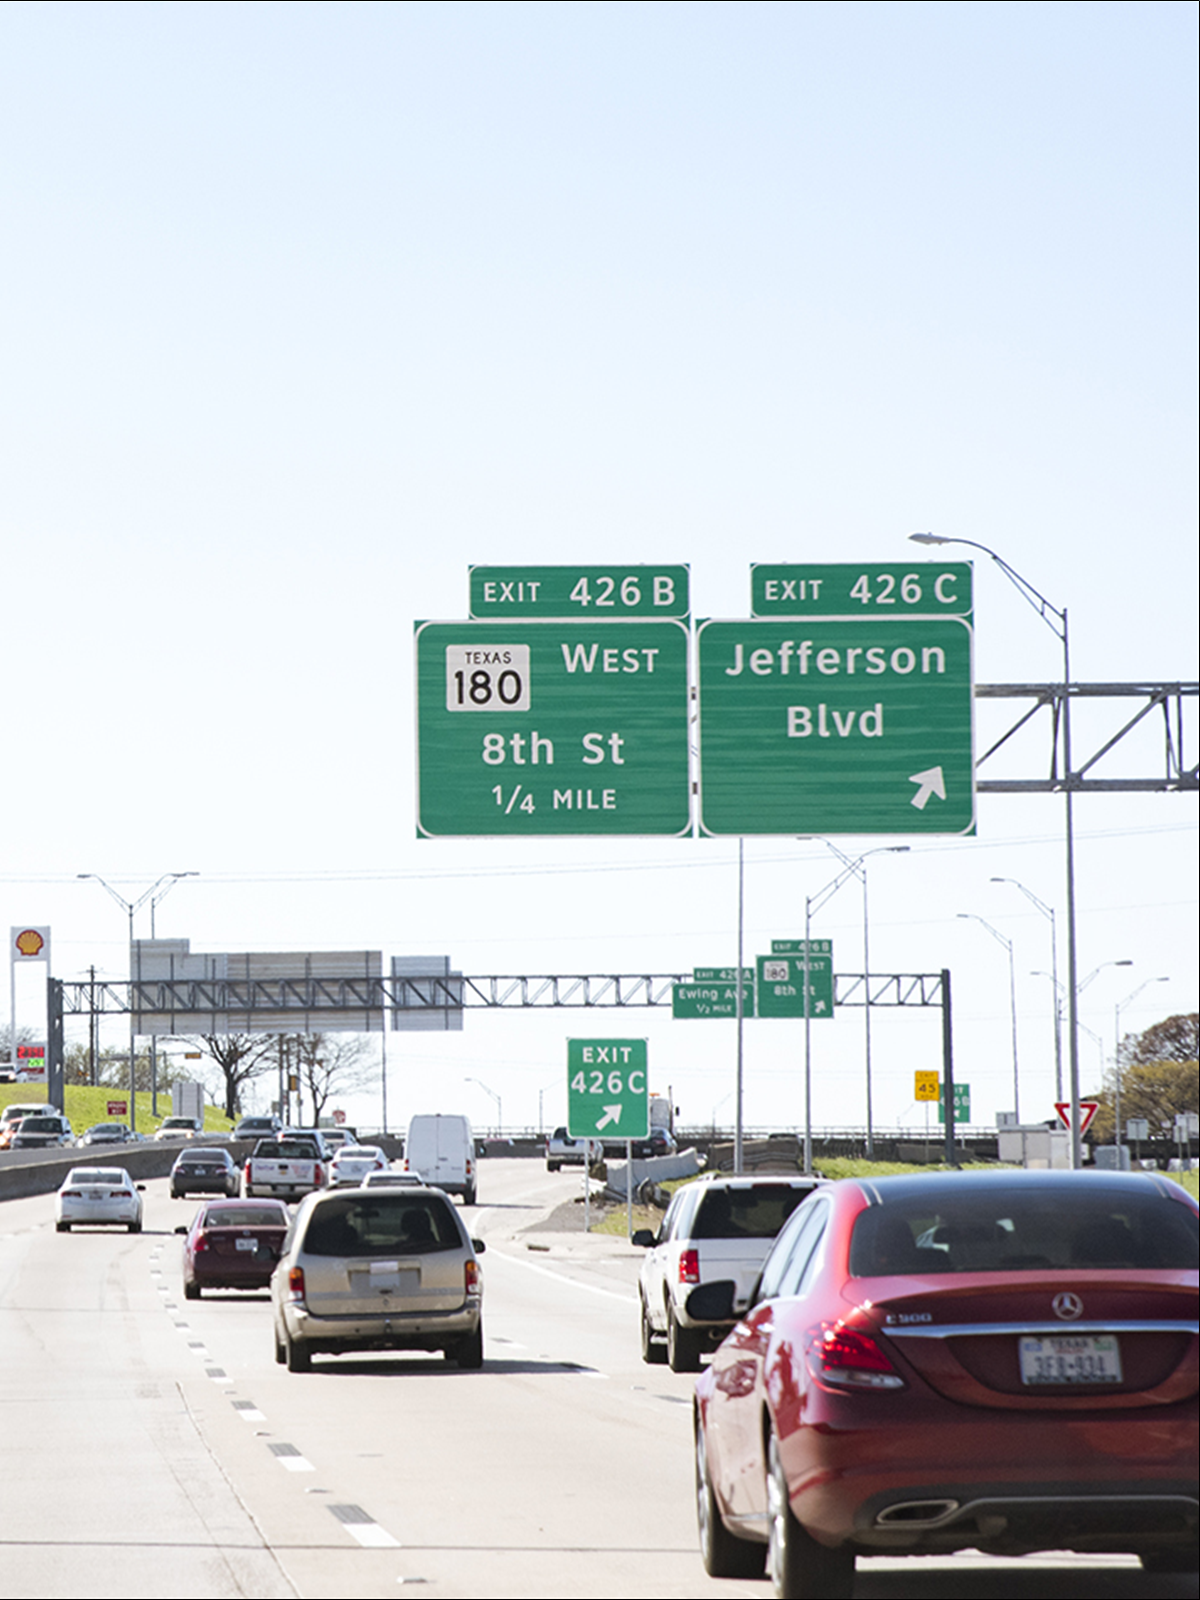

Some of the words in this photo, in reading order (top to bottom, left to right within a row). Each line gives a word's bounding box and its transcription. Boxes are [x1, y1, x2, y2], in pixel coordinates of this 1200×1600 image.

[484, 582, 541, 602] EXIT
[569, 576, 641, 606] 426
[653, 576, 676, 606] B
[765, 579, 823, 601] EXIT
[849, 573, 922, 604] 426
[934, 573, 958, 603] C
[465, 651, 511, 664] TEXAS
[561, 643, 659, 673] WEST
[725, 641, 946, 676] Jefferson
[454, 670, 522, 705] 180
[787, 703, 884, 738] Blvd
[482, 731, 554, 765] 8th
[582, 732, 625, 765] St
[492, 784, 536, 815] 1/4
[553, 789, 617, 810] MILE
[798, 942, 819, 951] 46
[743, 970, 752, 979] A
[766, 968, 786, 979] 180
[678, 988, 719, 1001] Ewing
[774, 985, 796, 996] 8th
[582, 1046, 632, 1064] EXIT
[918, 1083, 936, 1093] 45
